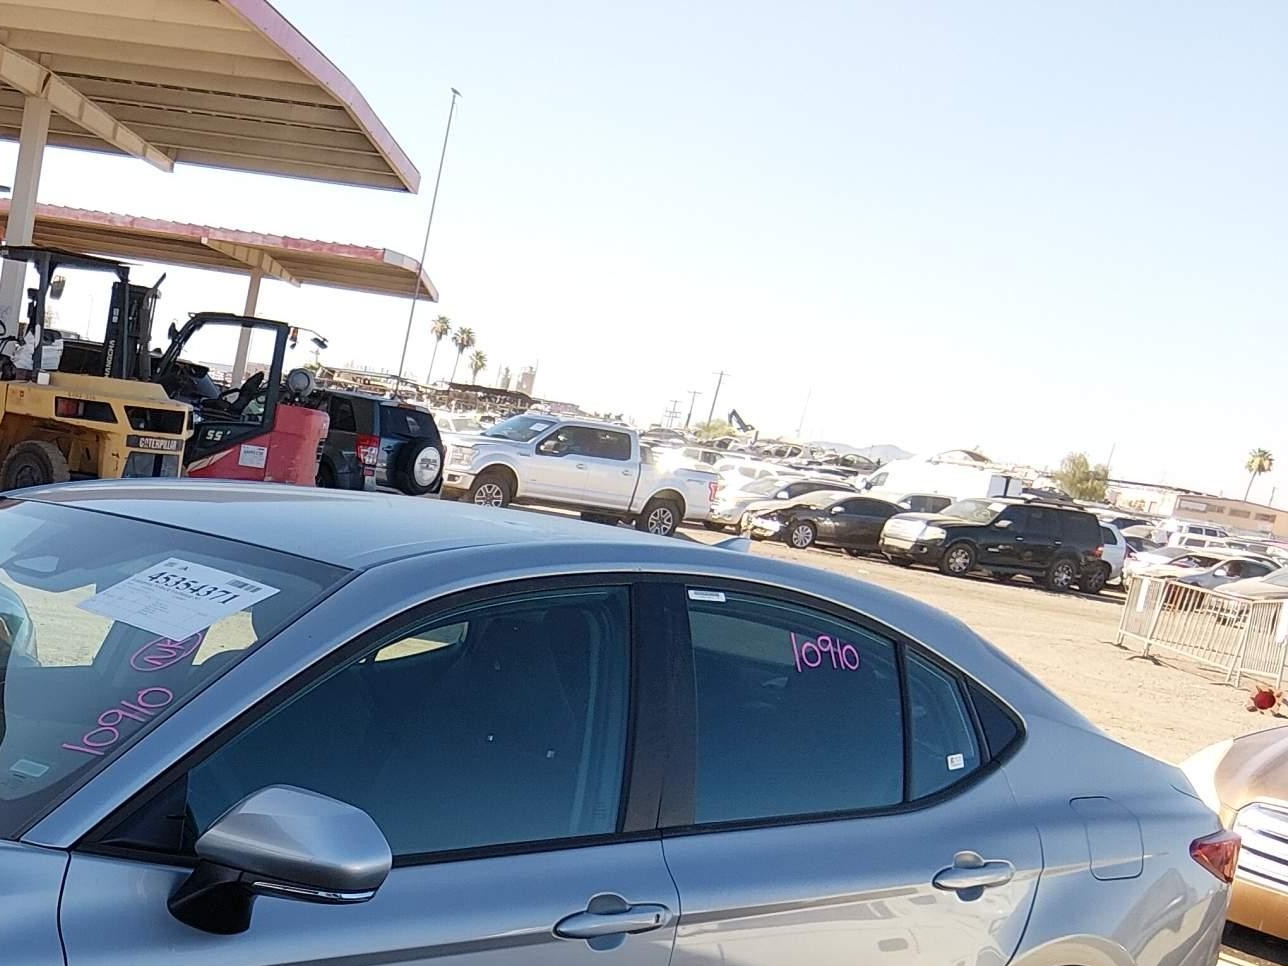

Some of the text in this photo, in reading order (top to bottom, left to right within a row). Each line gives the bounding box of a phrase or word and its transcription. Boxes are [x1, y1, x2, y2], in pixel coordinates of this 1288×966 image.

[139, 437, 177, 450] CATERPILLAR
[147, 571, 240, 604] 45354371
[790, 631, 860, 673] 10910
[61, 687, 173, 755] 10910
